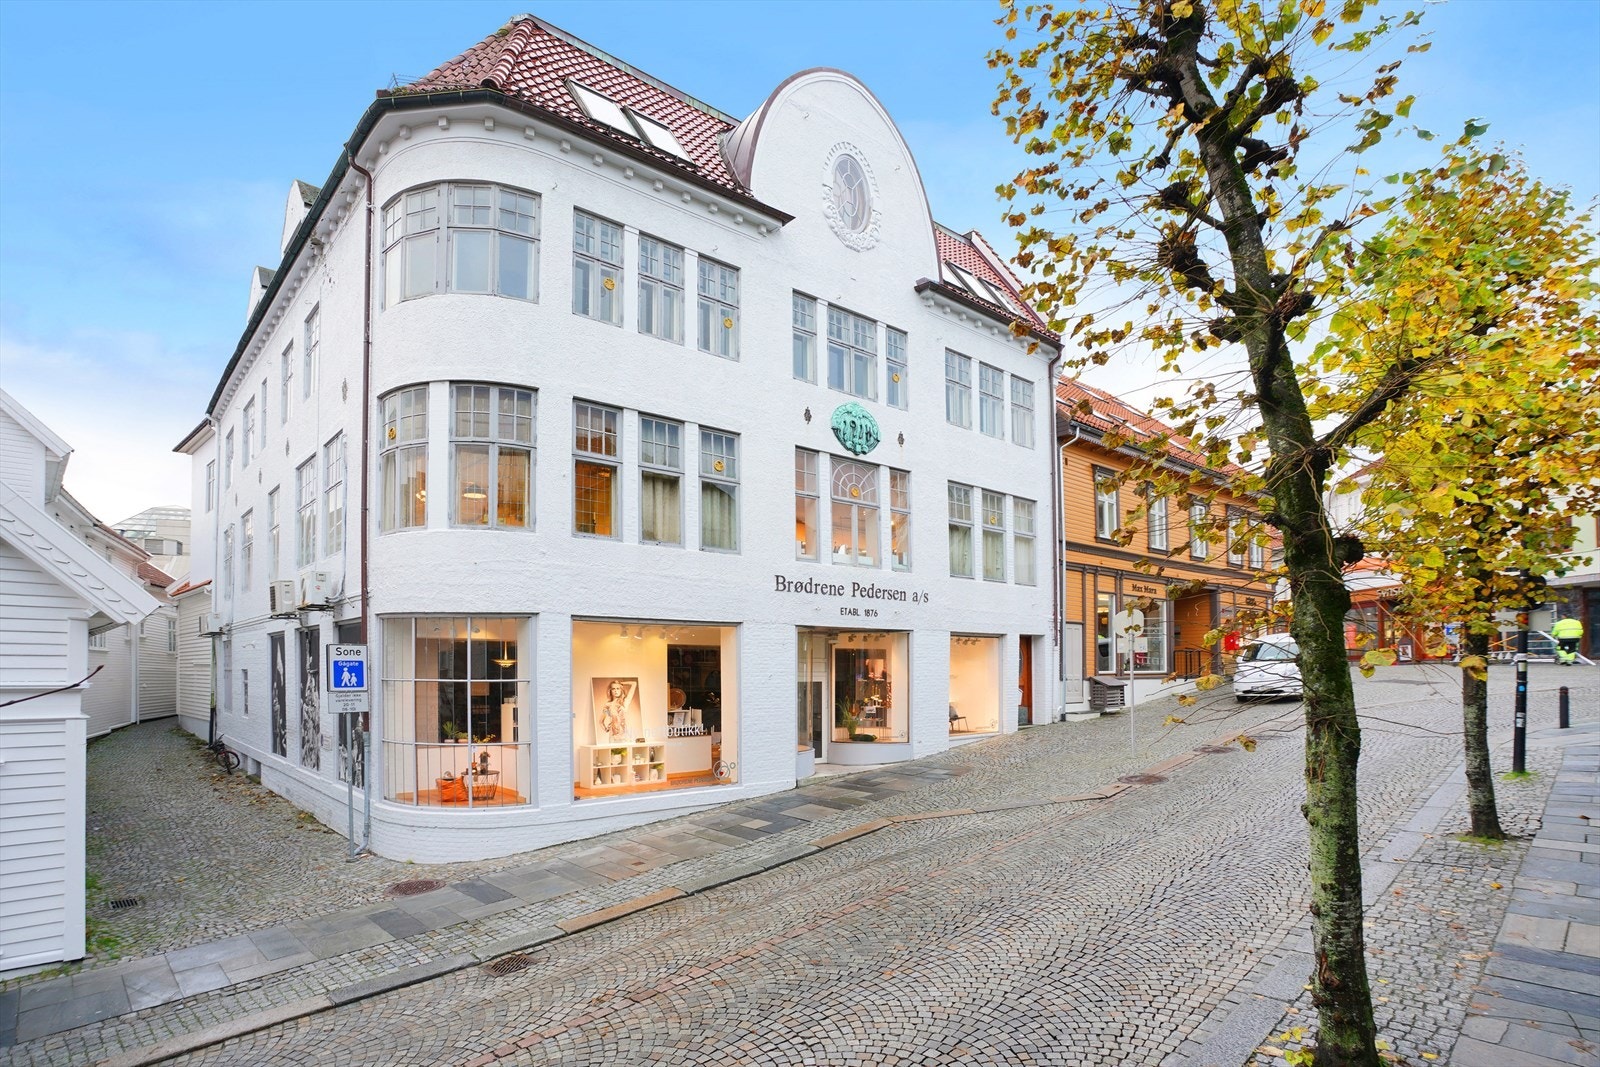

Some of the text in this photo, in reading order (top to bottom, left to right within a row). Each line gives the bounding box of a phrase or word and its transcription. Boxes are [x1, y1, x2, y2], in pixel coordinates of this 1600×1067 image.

[774, 574, 929, 605] Brødrene Pedersen a/s
[1132, 583, 1157, 594] Max Mara
[864, 608, 878, 618] 1876
[335, 647, 361, 656] Sone
